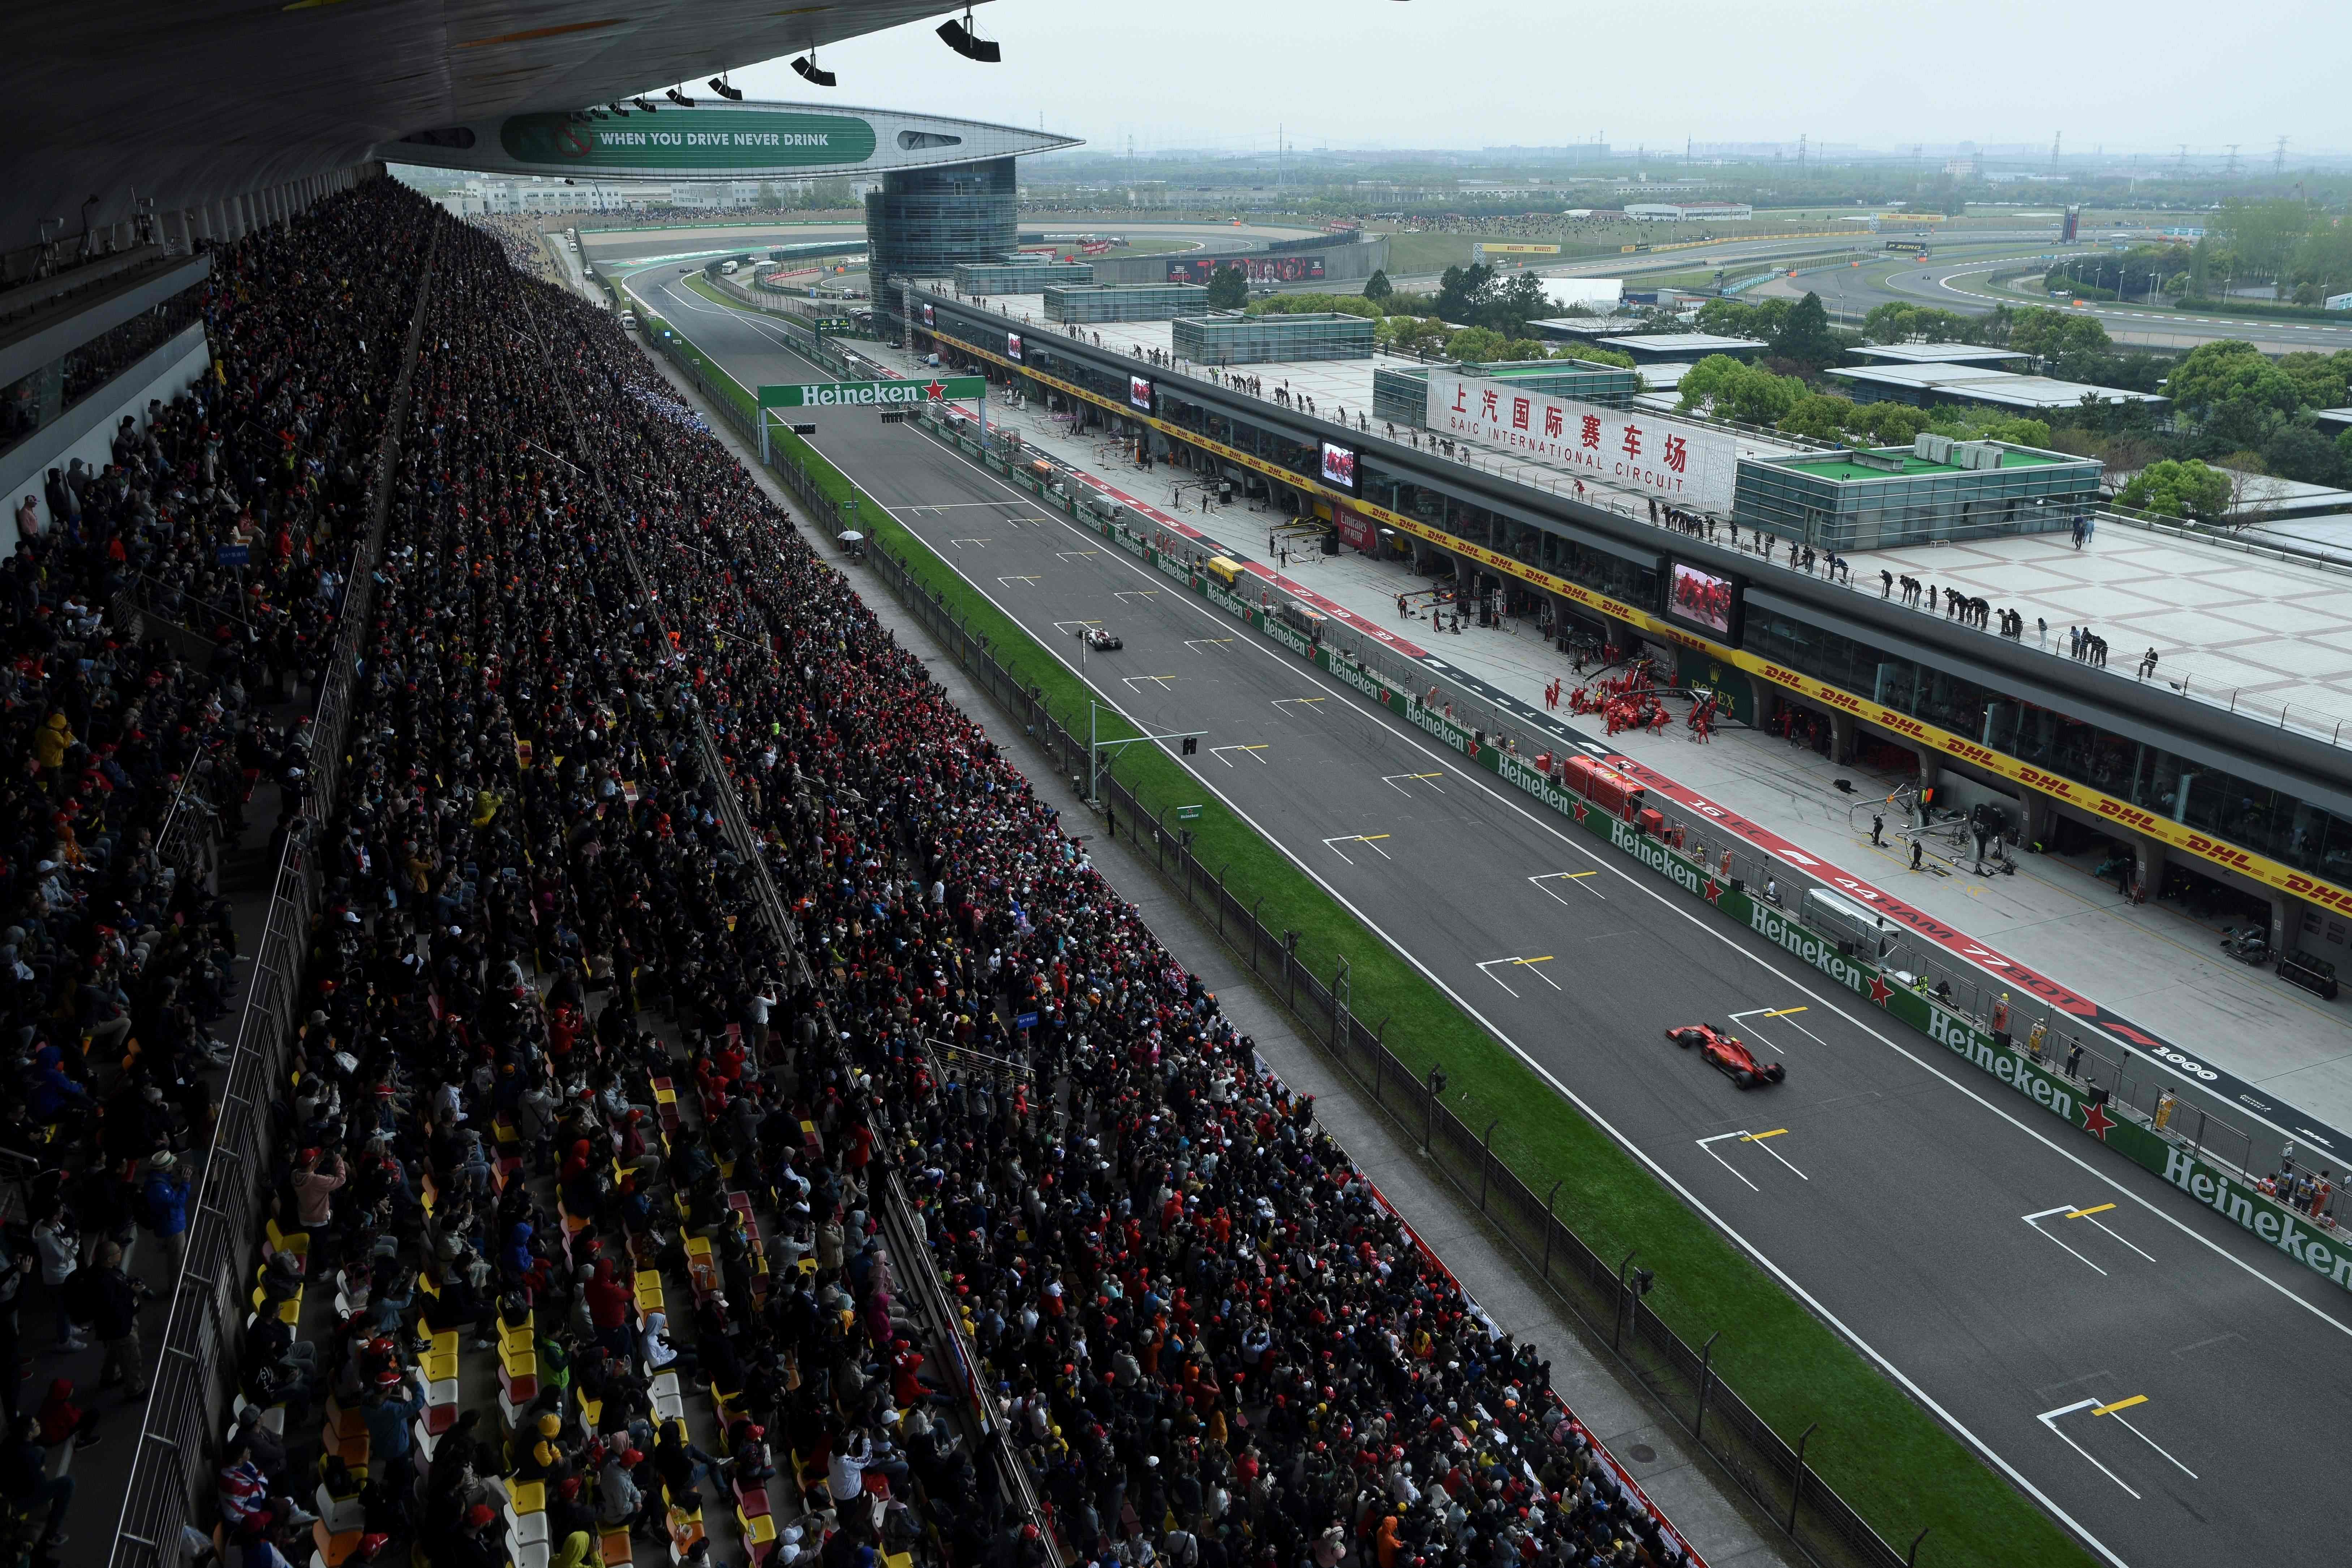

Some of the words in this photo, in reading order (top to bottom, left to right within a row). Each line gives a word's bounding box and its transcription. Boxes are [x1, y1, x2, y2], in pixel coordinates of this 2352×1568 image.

[600, 133, 646, 145] WHEN
[650, 133, 681, 145] YOU
[687, 133, 729, 145] DRIVE
[734, 134, 779, 145] NEVER
[784, 134, 829, 146] DRINK
[801, 383, 918, 406] Heineken
[1098, 398, 1107, 406] DHL
[1111, 403, 1120, 411] DHL
[1161, 423, 1172, 433] DHL
[1177, 430, 1188, 439] DHL
[1452, 383, 1686, 473] 上汽国际赛车场
[960, 438, 978, 457] Heineken
[1194, 436, 1206, 446] DHL
[1211, 443, 1223, 454] DHL
[985, 452, 1005, 474] Heineken
[1229, 450, 1242, 461] DHL
[1248, 458, 1261, 468] DHL
[1451, 416, 1479, 434] SAIC
[1488, 427, 1603, 470] INTERNATIONAL
[1615, 462, 1684, 492] CIRCUIT
[1013, 469, 1033, 491] Heineken
[1268, 466, 1282, 477] DHL
[1289, 475, 1304, 486] DHL
[1043, 485, 1065, 511] Heineken
[1077, 504, 1101, 533] Heineken
[1341, 511, 1367, 532] Emirates
[1372, 508, 1390, 521] DHL
[1350, 529, 1363, 544] BETTER
[1399, 519, 1418, 533] DHL
[1115, 527, 1143, 557] Heineken
[1427, 530, 1448, 545] DHL
[1458, 542, 1479, 558] DHL
[1158, 553, 1189, 585] Heineken
[1490, 555, 1513, 572] DHL
[1525, 569, 1550, 586] DHL
[1207, 581, 1243, 619] Heineken
[1562, 584, 1590, 603] DHL
[1601, 600, 1630, 619] DHL
[1264, 615, 1306, 657] Heineken
[1329, 656, 1377, 701] Heineken
[1764, 665, 1801, 689] DHL
[1820, 687, 1861, 713] DHL
[1406, 700, 1464, 752] Heineken
[1880, 712, 1925, 739] DHL
[1946, 738, 1995, 767] DHL
[1498, 753, 1568, 816] Heineken
[2018, 767, 2072, 798] DHL
[2097, 799, 2157, 833] DHL
[1611, 819, 1698, 893] Heineken
[2186, 834, 2253, 872] DHL
[2283, 874, 2352, 913] DHL
[1750, 902, 1861, 992] Heineken
[1927, 1006, 2071, 1120] Heineken
[2152, 1046, 2218, 1080] 1000
[2240, 1096, 2261, 1109] WALKER
[2241, 1094, 2265, 1107] JOHNNIE
[2162, 1145, 2352, 1292] Heineken
